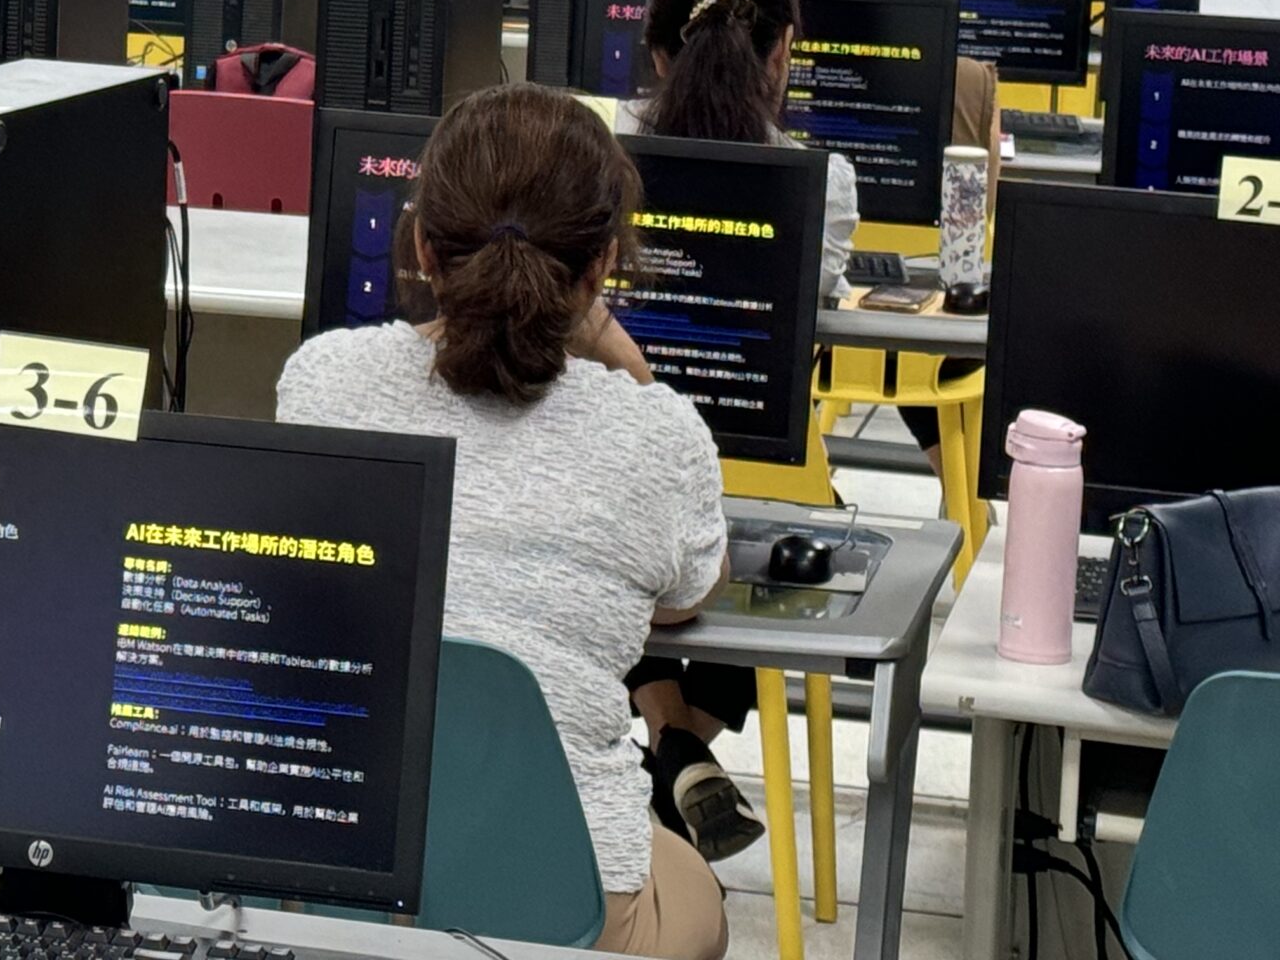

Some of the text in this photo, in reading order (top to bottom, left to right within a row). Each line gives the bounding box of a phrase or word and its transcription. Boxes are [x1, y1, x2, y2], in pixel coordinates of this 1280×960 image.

[10, 362, 125, 430] 3-6
[125, 522, 376, 566] AI在未來工作場所的潛在角色
[28, 839, 53, 868] hp
